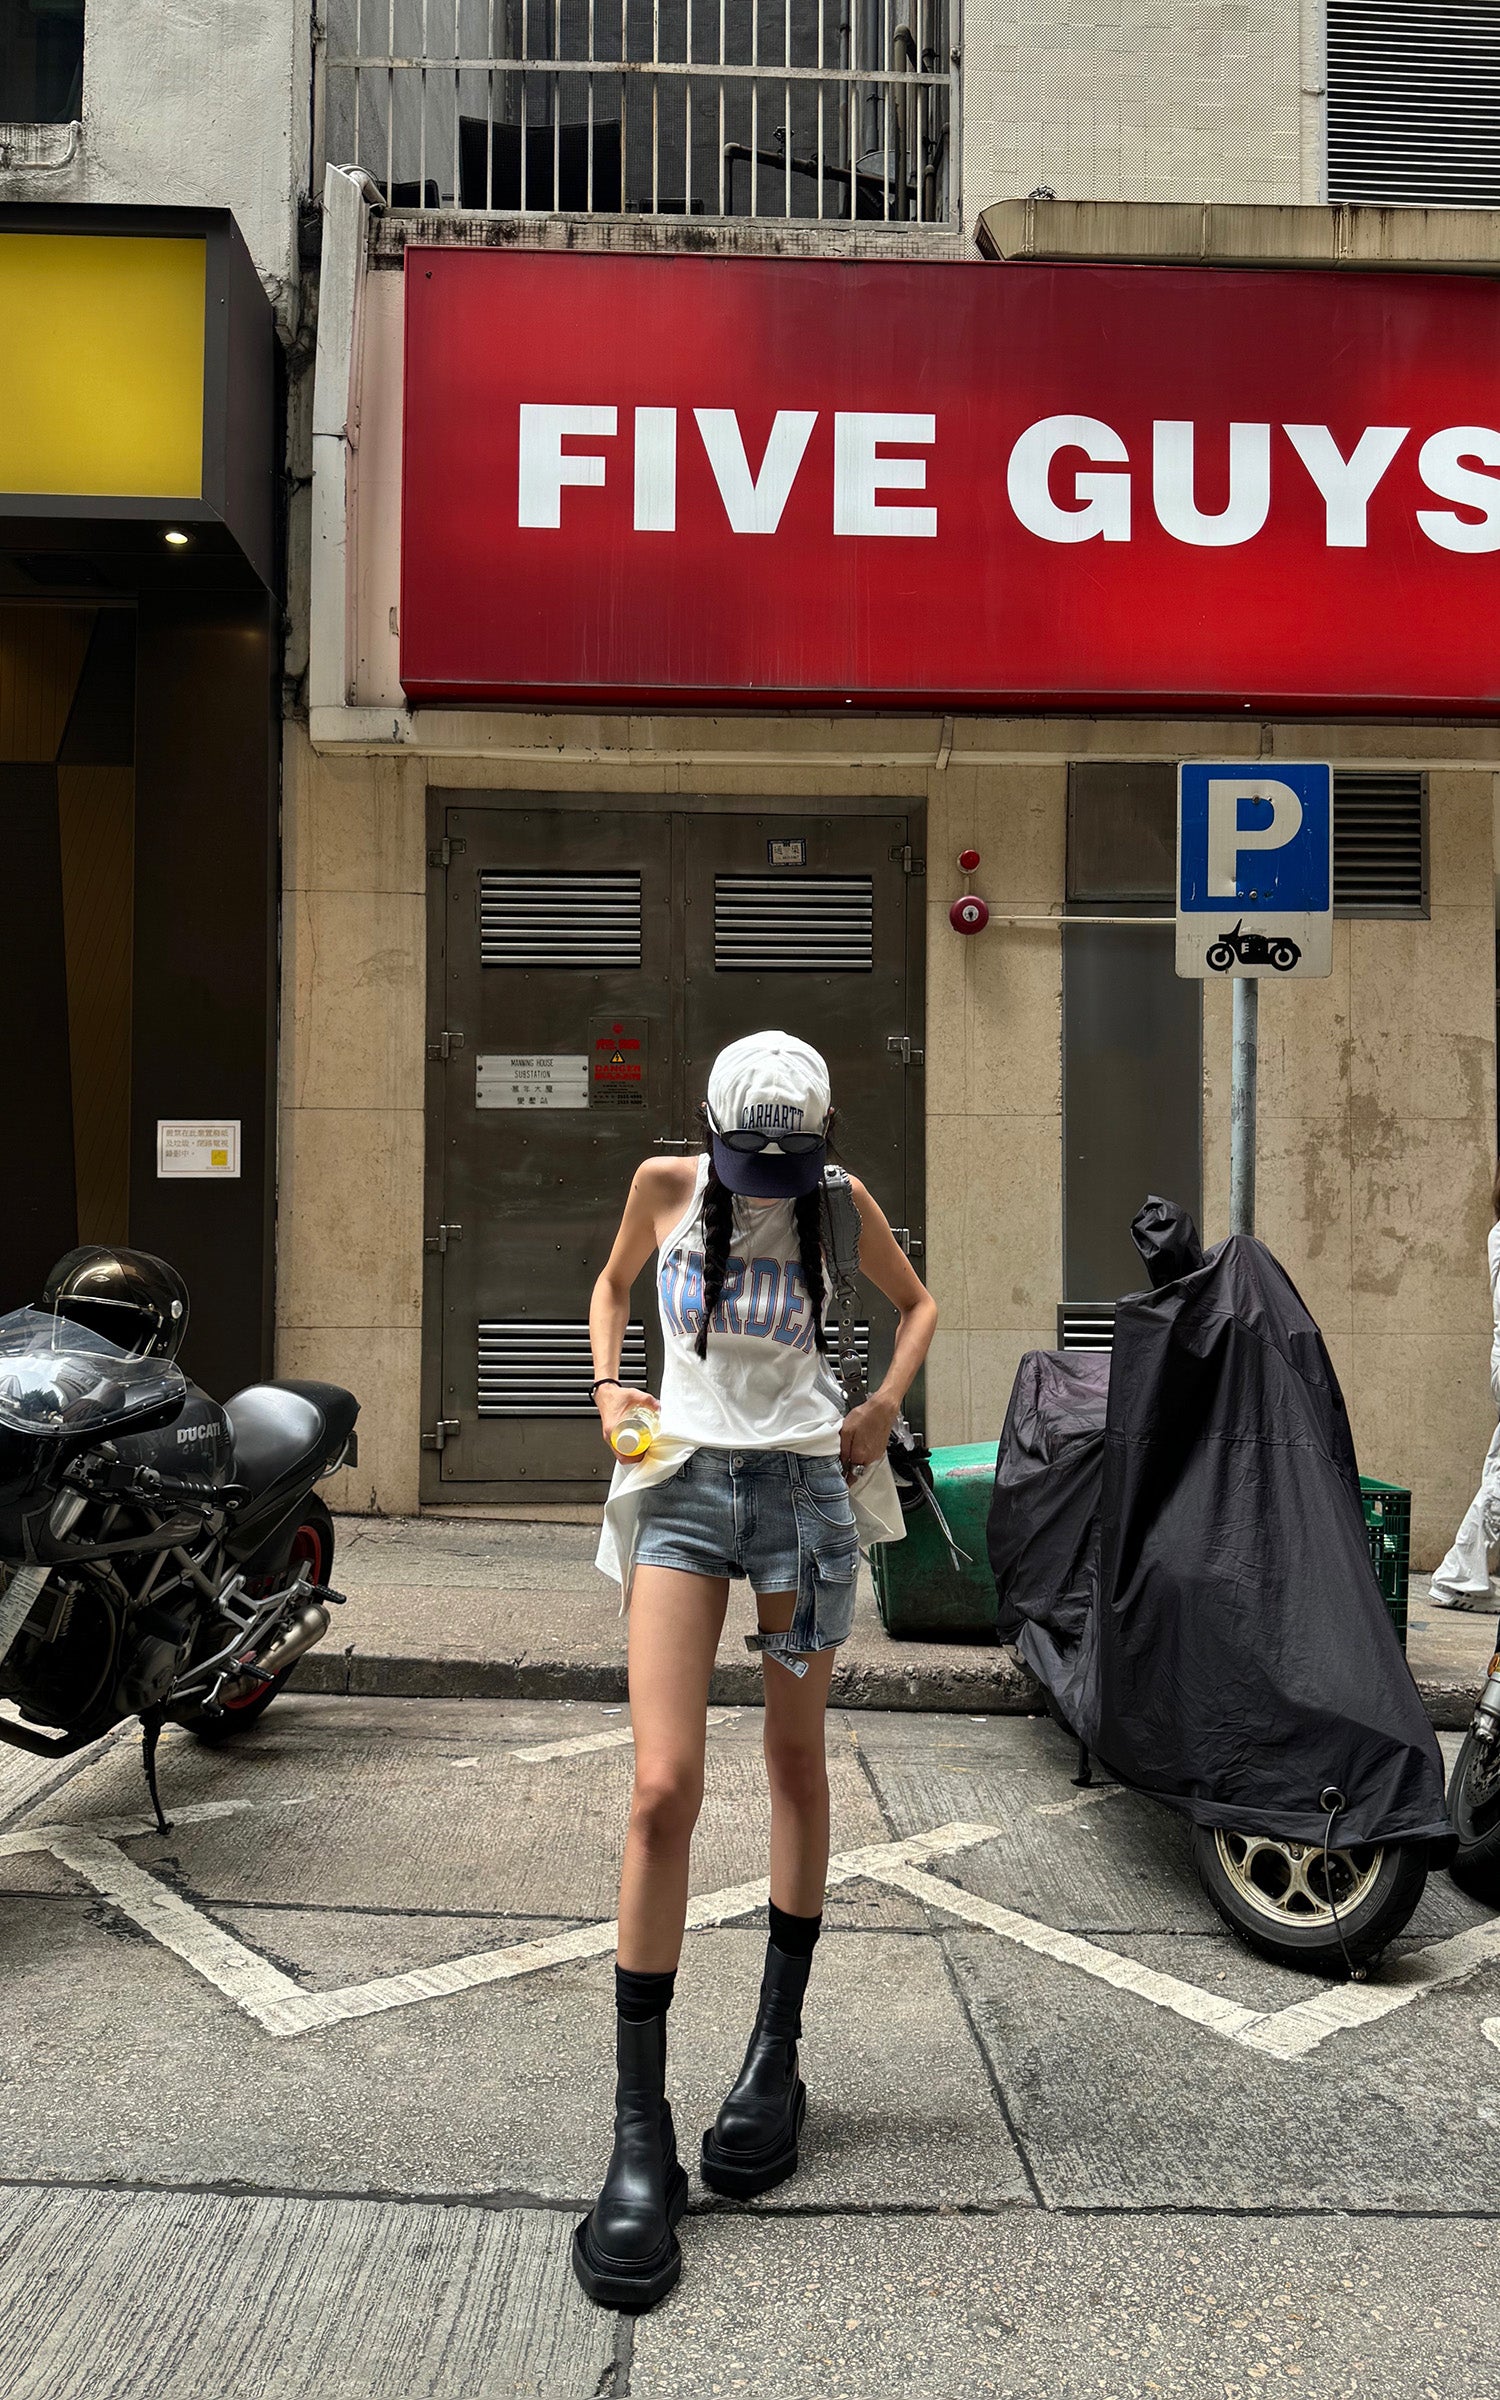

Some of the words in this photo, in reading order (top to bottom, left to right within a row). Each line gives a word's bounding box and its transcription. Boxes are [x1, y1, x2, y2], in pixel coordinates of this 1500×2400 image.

[519, 404, 937, 537] FIVE
[1007, 415, 1500, 553] GUYS
[1208, 779, 1303, 897] P
[511, 1058, 534, 1067] MANNING
[536, 1058, 554, 1067] HOUSE
[514, 1069, 551, 1079] SUBSTATION
[741, 1103, 804, 1131] CARHARTT
[177, 1422, 221, 1444] DUCATI
